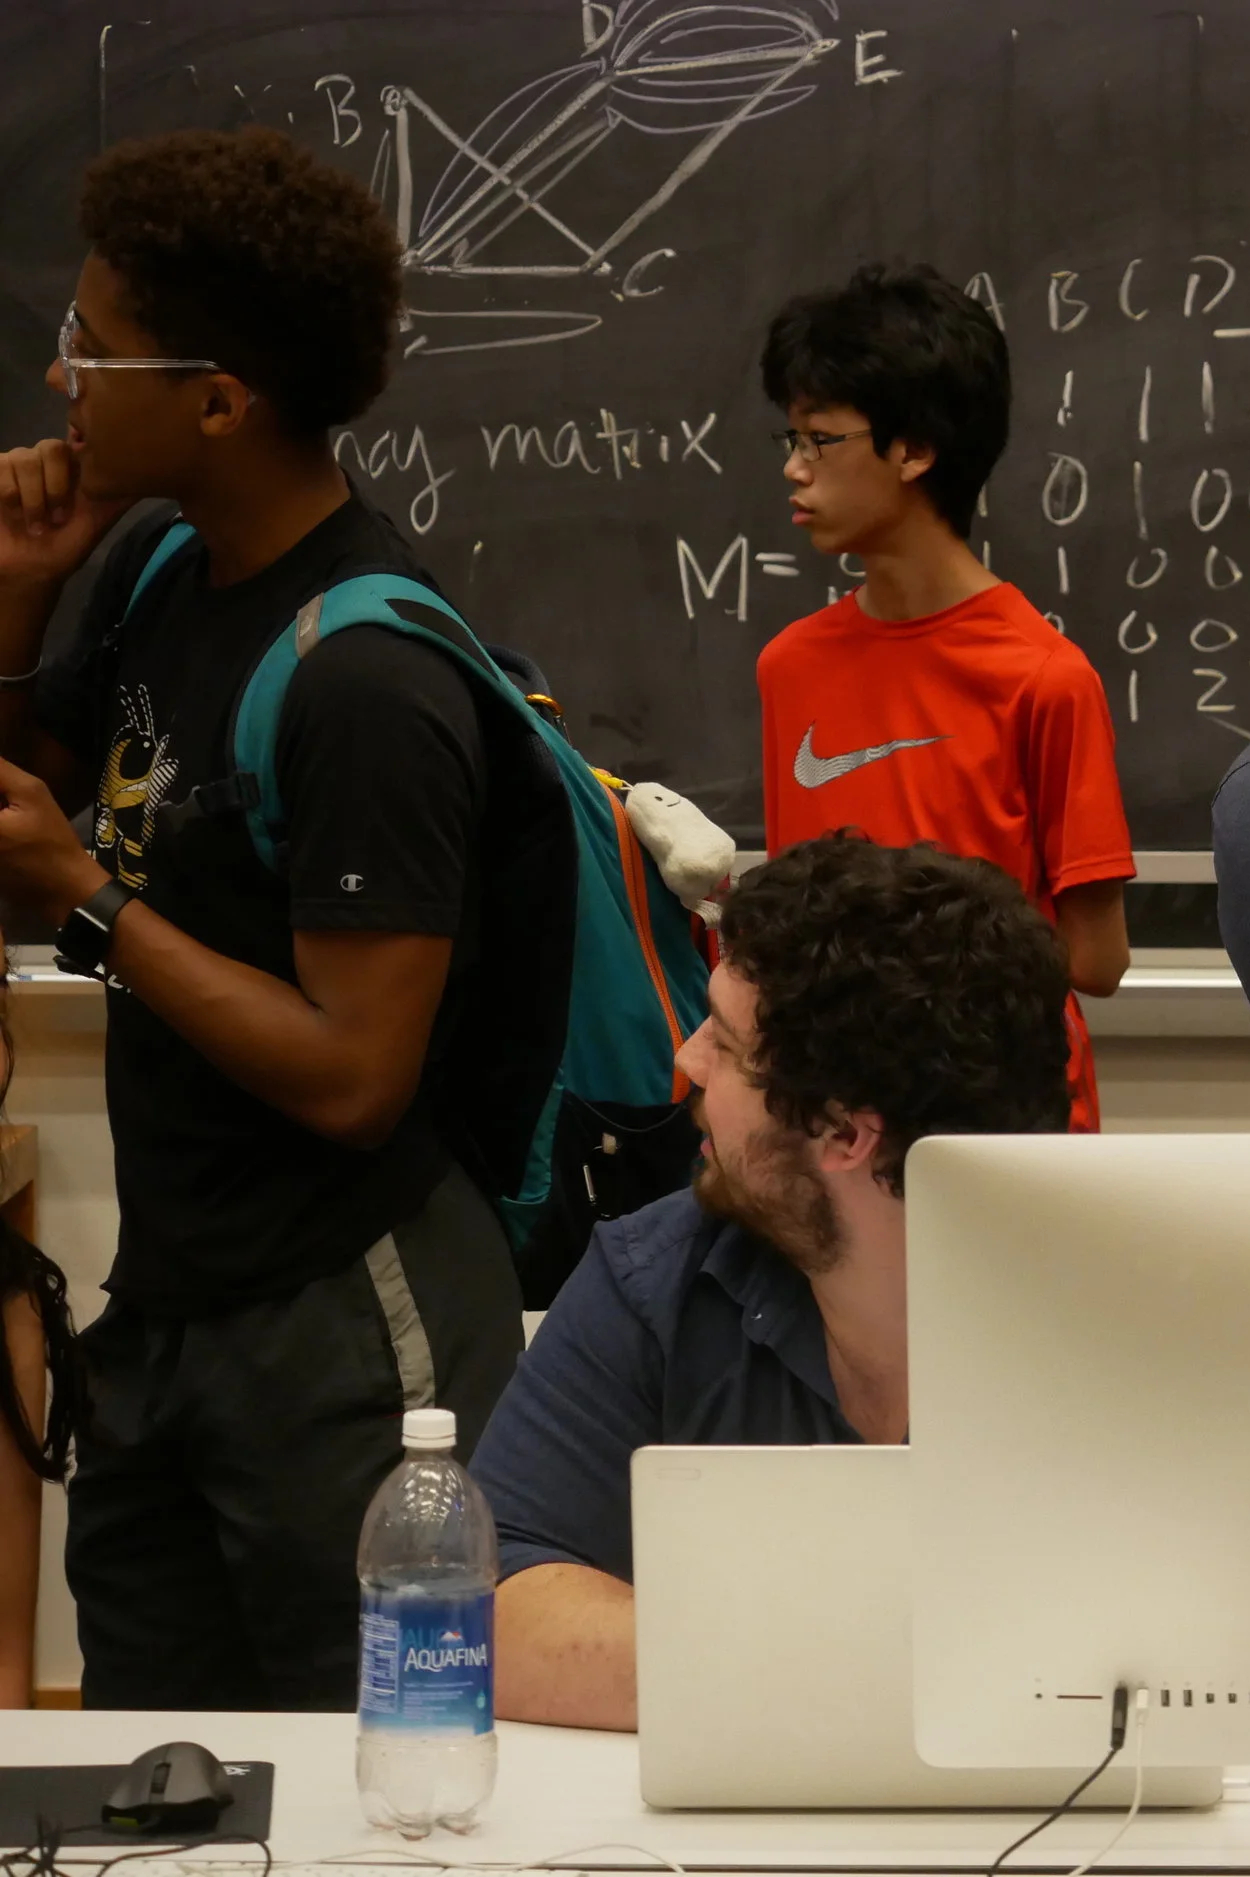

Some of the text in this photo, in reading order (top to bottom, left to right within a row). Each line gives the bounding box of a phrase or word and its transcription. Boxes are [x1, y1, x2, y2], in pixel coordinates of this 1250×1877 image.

[855, 30, 903, 86] E
[315, 73, 363, 148] B
[621, 247, 677, 298] C
[1048, 270, 1090, 333] B
[1183, 254, 1236, 318] D
[481, 408, 723, 481] matrix
[403, 1642, 489, 1673] AQUAFINA
